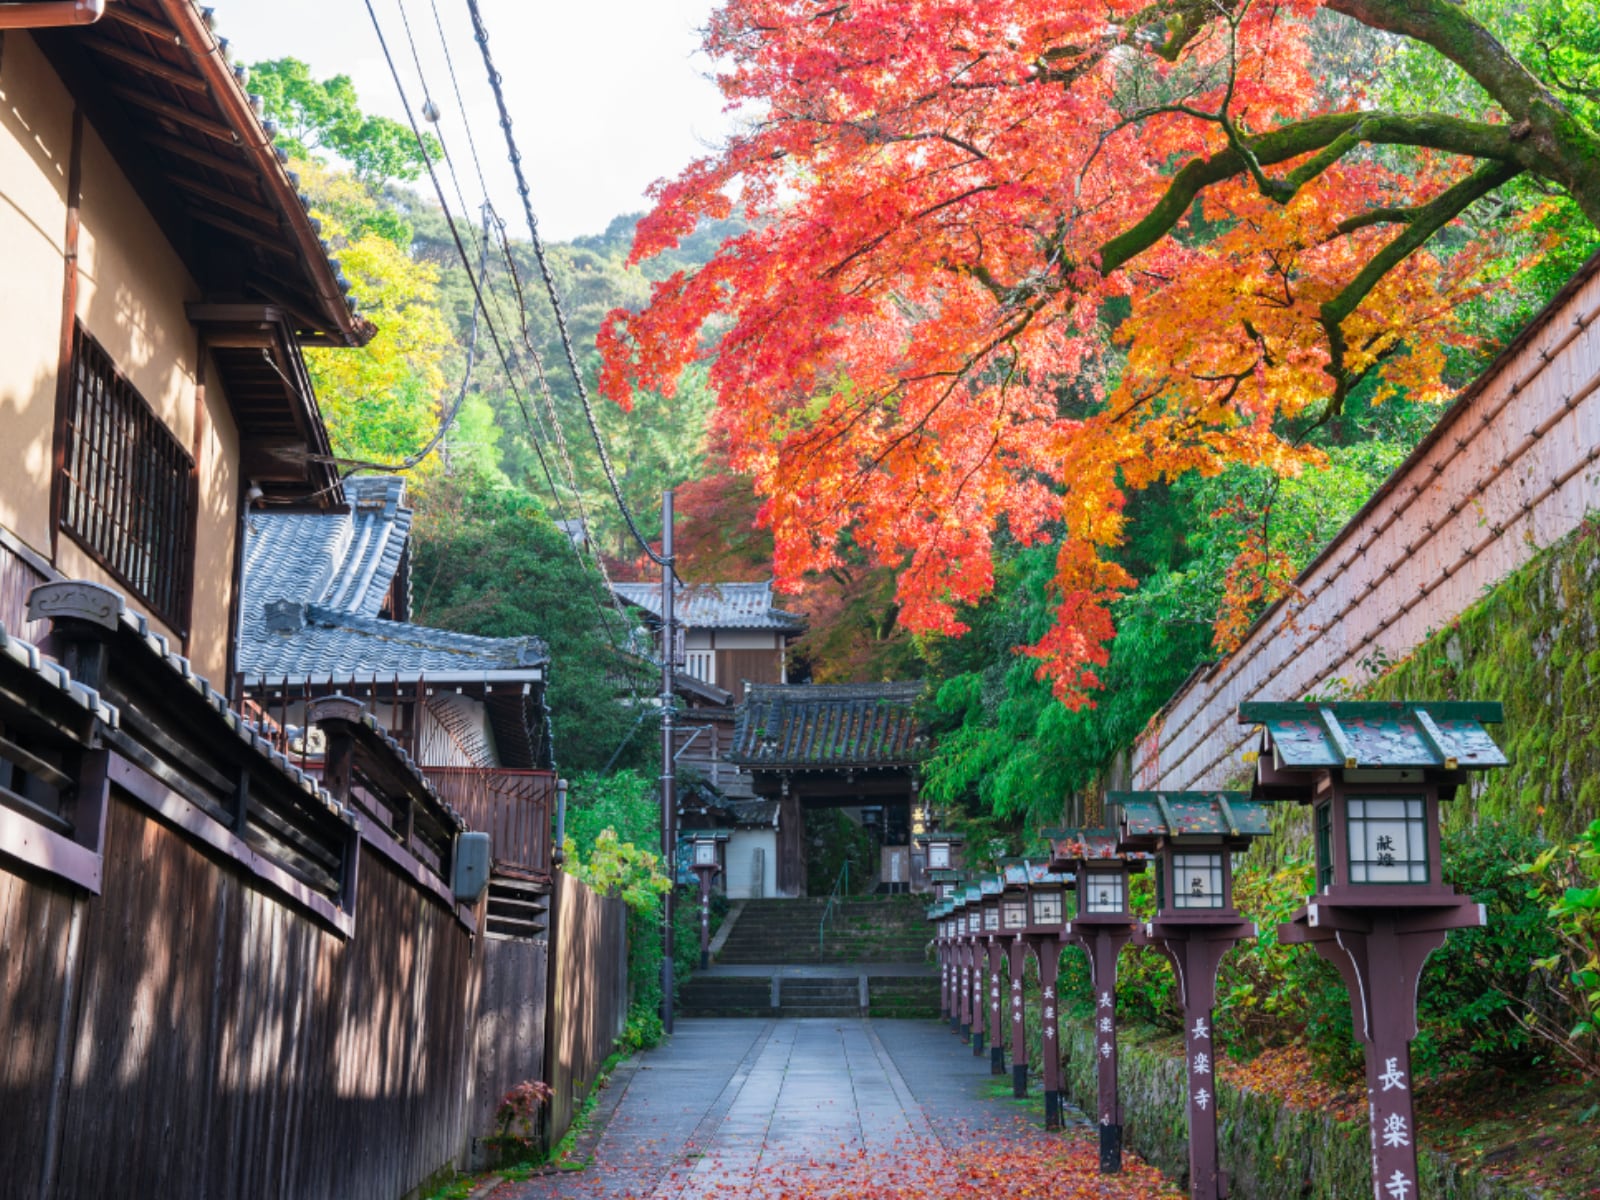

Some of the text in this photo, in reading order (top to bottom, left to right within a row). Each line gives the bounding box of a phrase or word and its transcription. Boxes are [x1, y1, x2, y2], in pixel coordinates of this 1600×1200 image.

[1191, 1017, 1211, 1111] 長楽寺
[1378, 1057, 1412, 1200] 長楽寺
